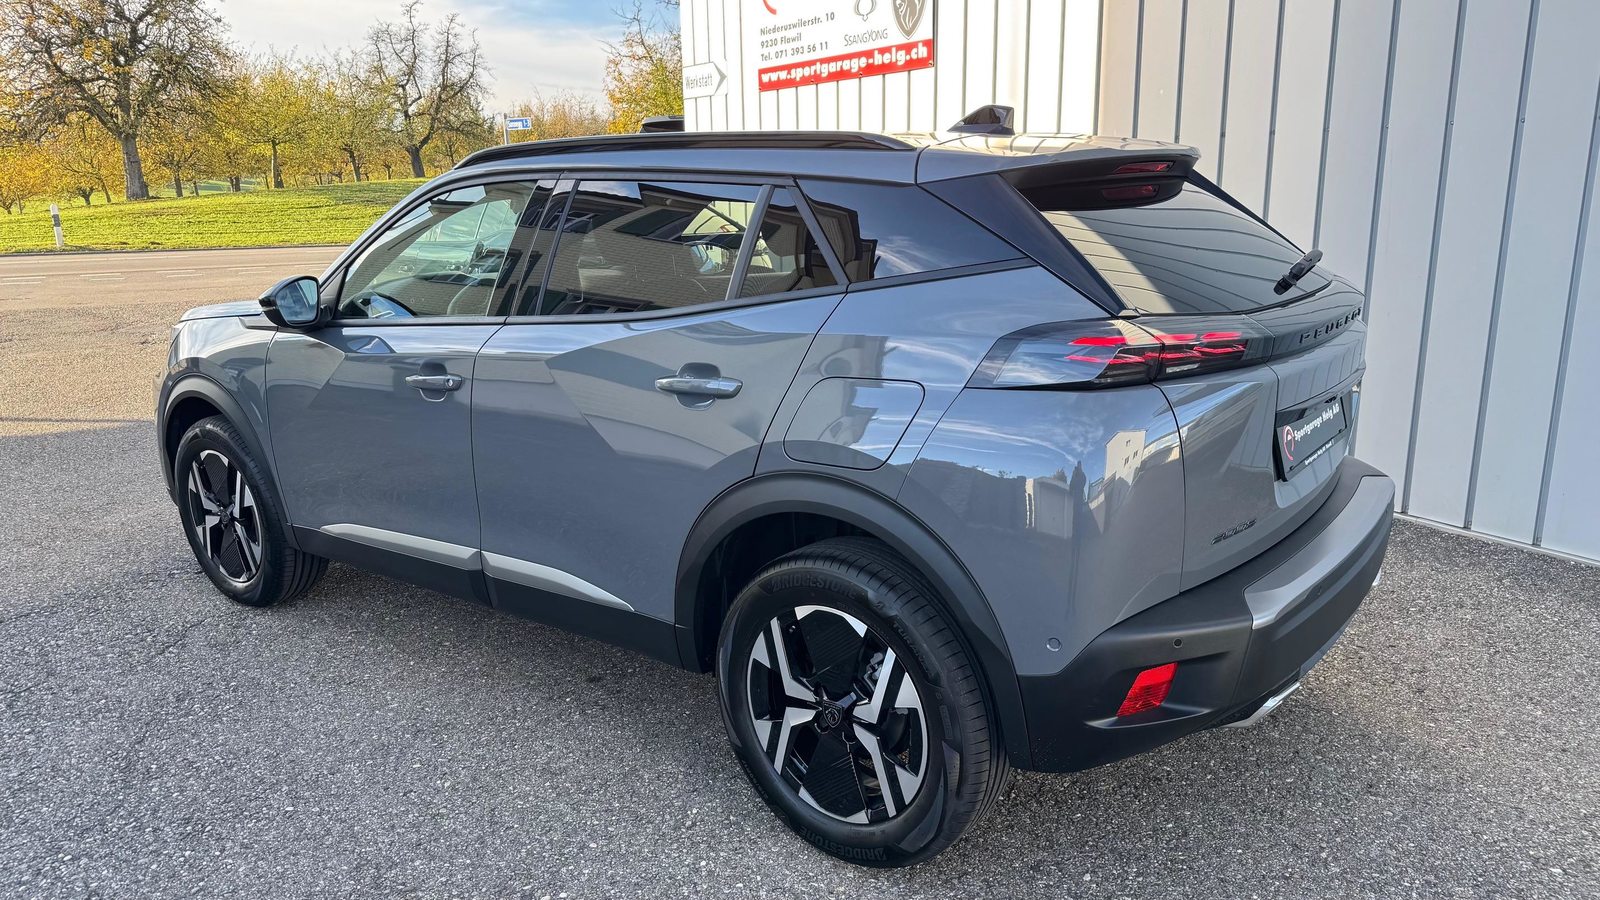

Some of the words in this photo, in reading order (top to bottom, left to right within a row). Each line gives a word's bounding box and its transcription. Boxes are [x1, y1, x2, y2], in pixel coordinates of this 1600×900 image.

[825, 11, 835, 22] 10
[760, 38, 778, 49] 9230
[780, 32, 802, 45] Flawil
[760, 52, 773, 62] Tel.
[774, 49, 788, 60] 071
[790, 46, 805, 56] 393
[807, 43, 817, 53] 56
[819, 41, 828, 51] 11
[760, 43, 929, 83] www.sportgarage-helg.ch
[1294, 416, 1323, 442] Sportgarage
